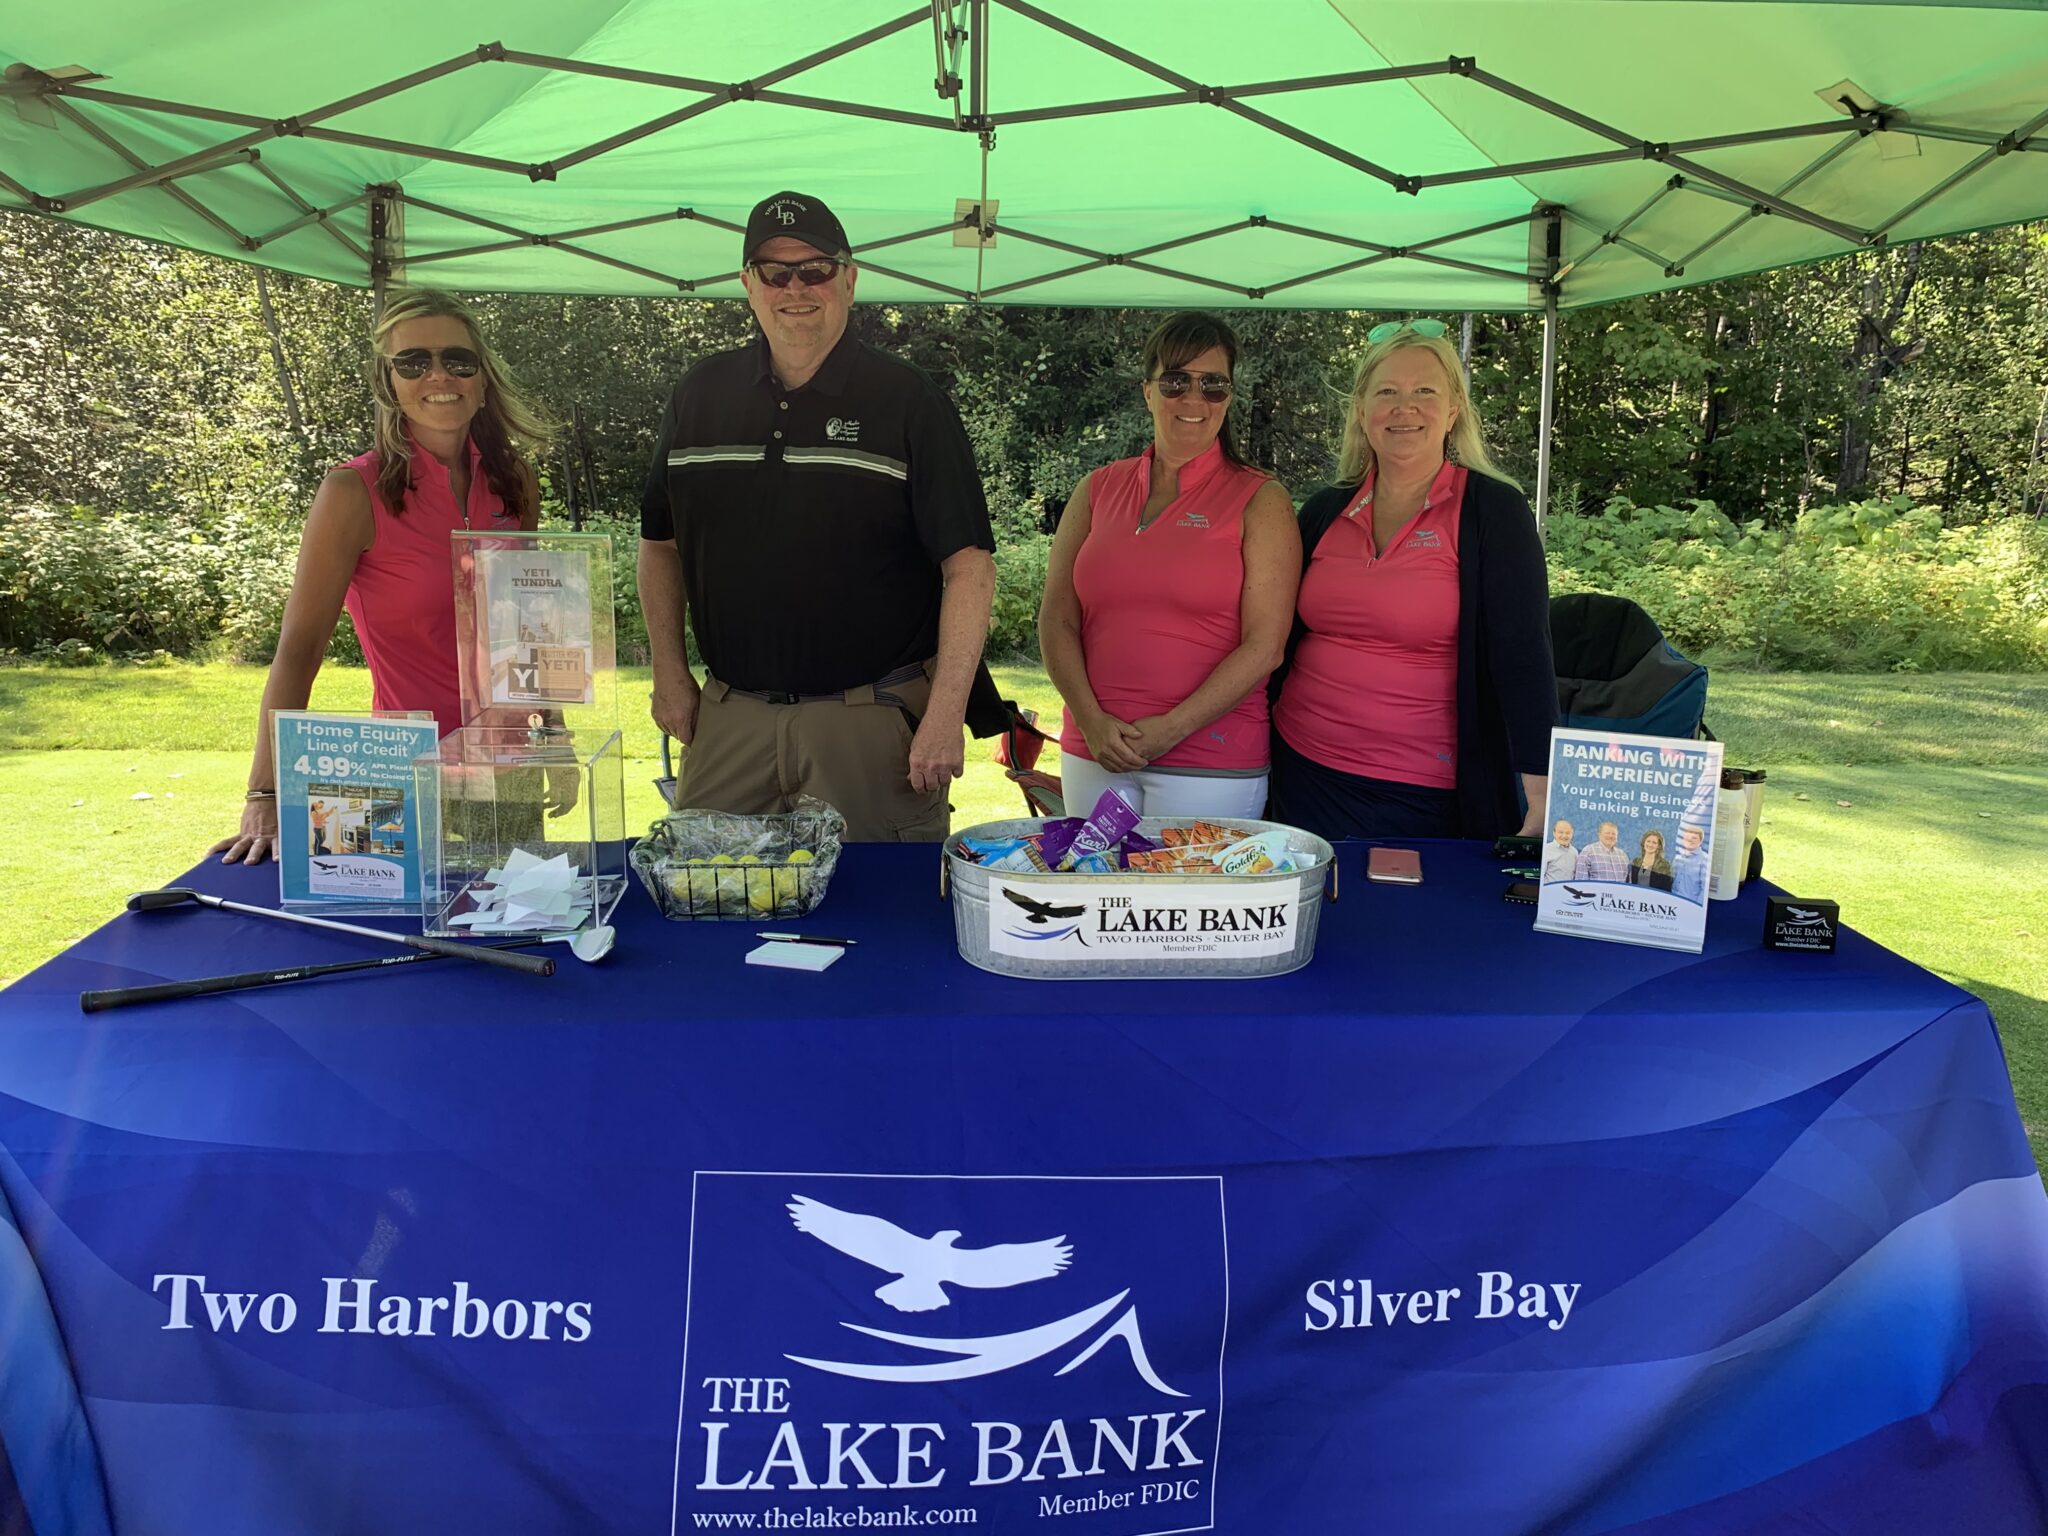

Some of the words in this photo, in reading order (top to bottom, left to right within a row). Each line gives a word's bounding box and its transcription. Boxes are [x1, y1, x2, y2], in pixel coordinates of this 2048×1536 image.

[765, 205, 775, 215] THE
[775, 200, 790, 208] LAKE
[792, 201, 808, 211] BANK
[512, 578, 563, 587] TUNDRA
[522, 568, 550, 577] YETI
[542, 659, 579, 671] YETI
[296, 721, 354, 737] Home
[360, 725, 419, 745] Equity
[307, 738, 339, 752] Line
[343, 741, 359, 754] of
[362, 743, 408, 757] Credit
[1562, 743, 1653, 765] BANKING
[1659, 752, 1712, 771] WITH
[294, 754, 367, 777] 4.99%
[1578, 763, 1693, 788] EXPERIENCE
[381, 773, 406, 781] Closing
[1561, 783, 1595, 797] Your
[1599, 787, 1635, 801] local
[1640, 792, 1706, 809] Business
[1579, 799, 1639, 818] Banking
[1225, 845, 1266, 873] Goldfish
[341, 867, 366, 875] LAKE
[369, 869, 396, 878] BANK
[1099, 897, 1132, 907] THE
[1600, 897, 1635, 911] LAKE
[1639, 902, 1678, 917] BANK
[1097, 909, 1188, 932] LAKE
[1197, 903, 1288, 932] BANK
[1096, 935, 1132, 943] TWO
[1135, 935, 1203, 943] HARBORS
[1214, 933, 1260, 943] SILVER
[1263, 929, 1286, 941] BAY
[1776, 927, 1802, 935] LAKE
[1804, 929, 1832, 937] BANK
[1163, 944, 1196, 952] Member
[1198, 944, 1217, 952] FDIC
[152, 1273, 297, 1334] Two
[317, 1277, 592, 1342] Harbors
[1305, 1278, 1461, 1332] Silver
[1474, 1271, 1582, 1331] Bay
[702, 1377, 791, 1413] THE
[696, 1420, 946, 1491] LAKE
[969, 1408, 1206, 1487] BANK
[1038, 1488, 1136, 1517] Member
[1140, 1479, 1200, 1504] FDIC
[692, 1504, 978, 1530] www.thelakebank.com
